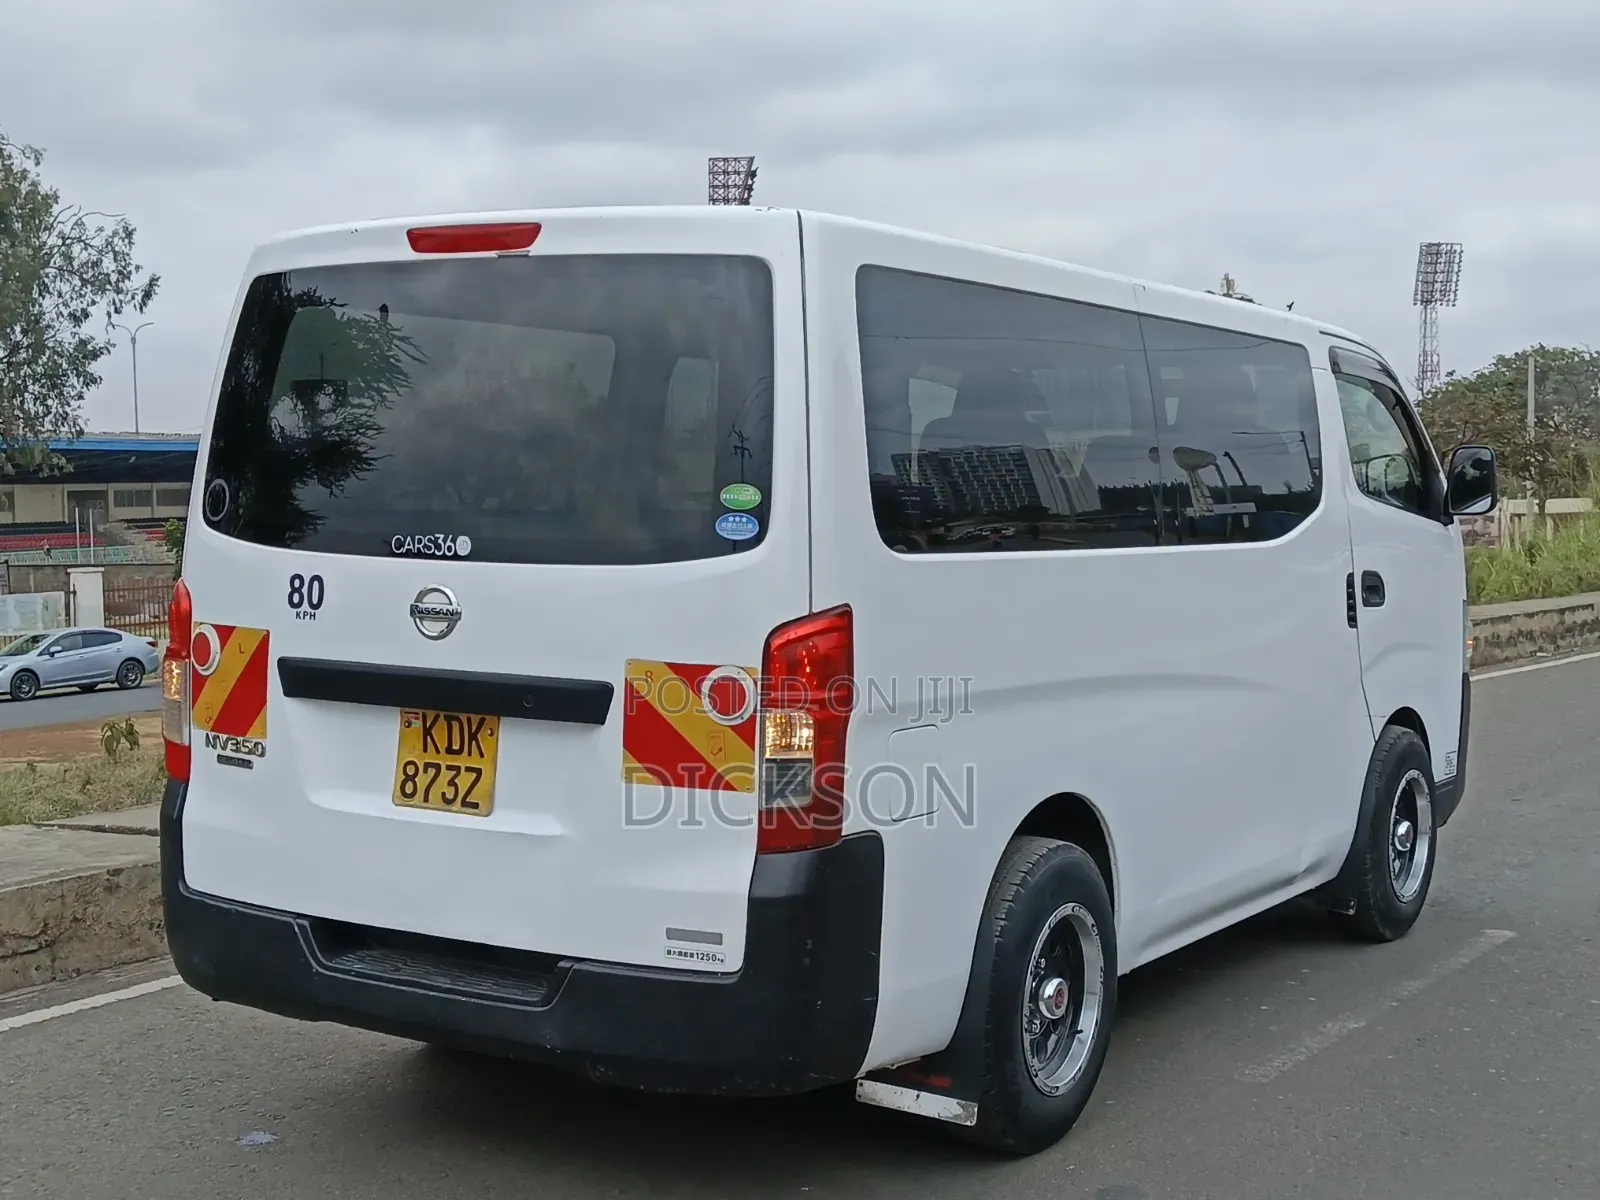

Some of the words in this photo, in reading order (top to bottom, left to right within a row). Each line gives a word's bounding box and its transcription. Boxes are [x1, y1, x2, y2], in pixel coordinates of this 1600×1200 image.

[288, 573, 325, 610] 80
[295, 610, 316, 620] KPH
[413, 604, 454, 616] NISSAN
[205, 732, 266, 757] NV350
[422, 711, 486, 758] KDK
[400, 760, 483, 809] 873Z
